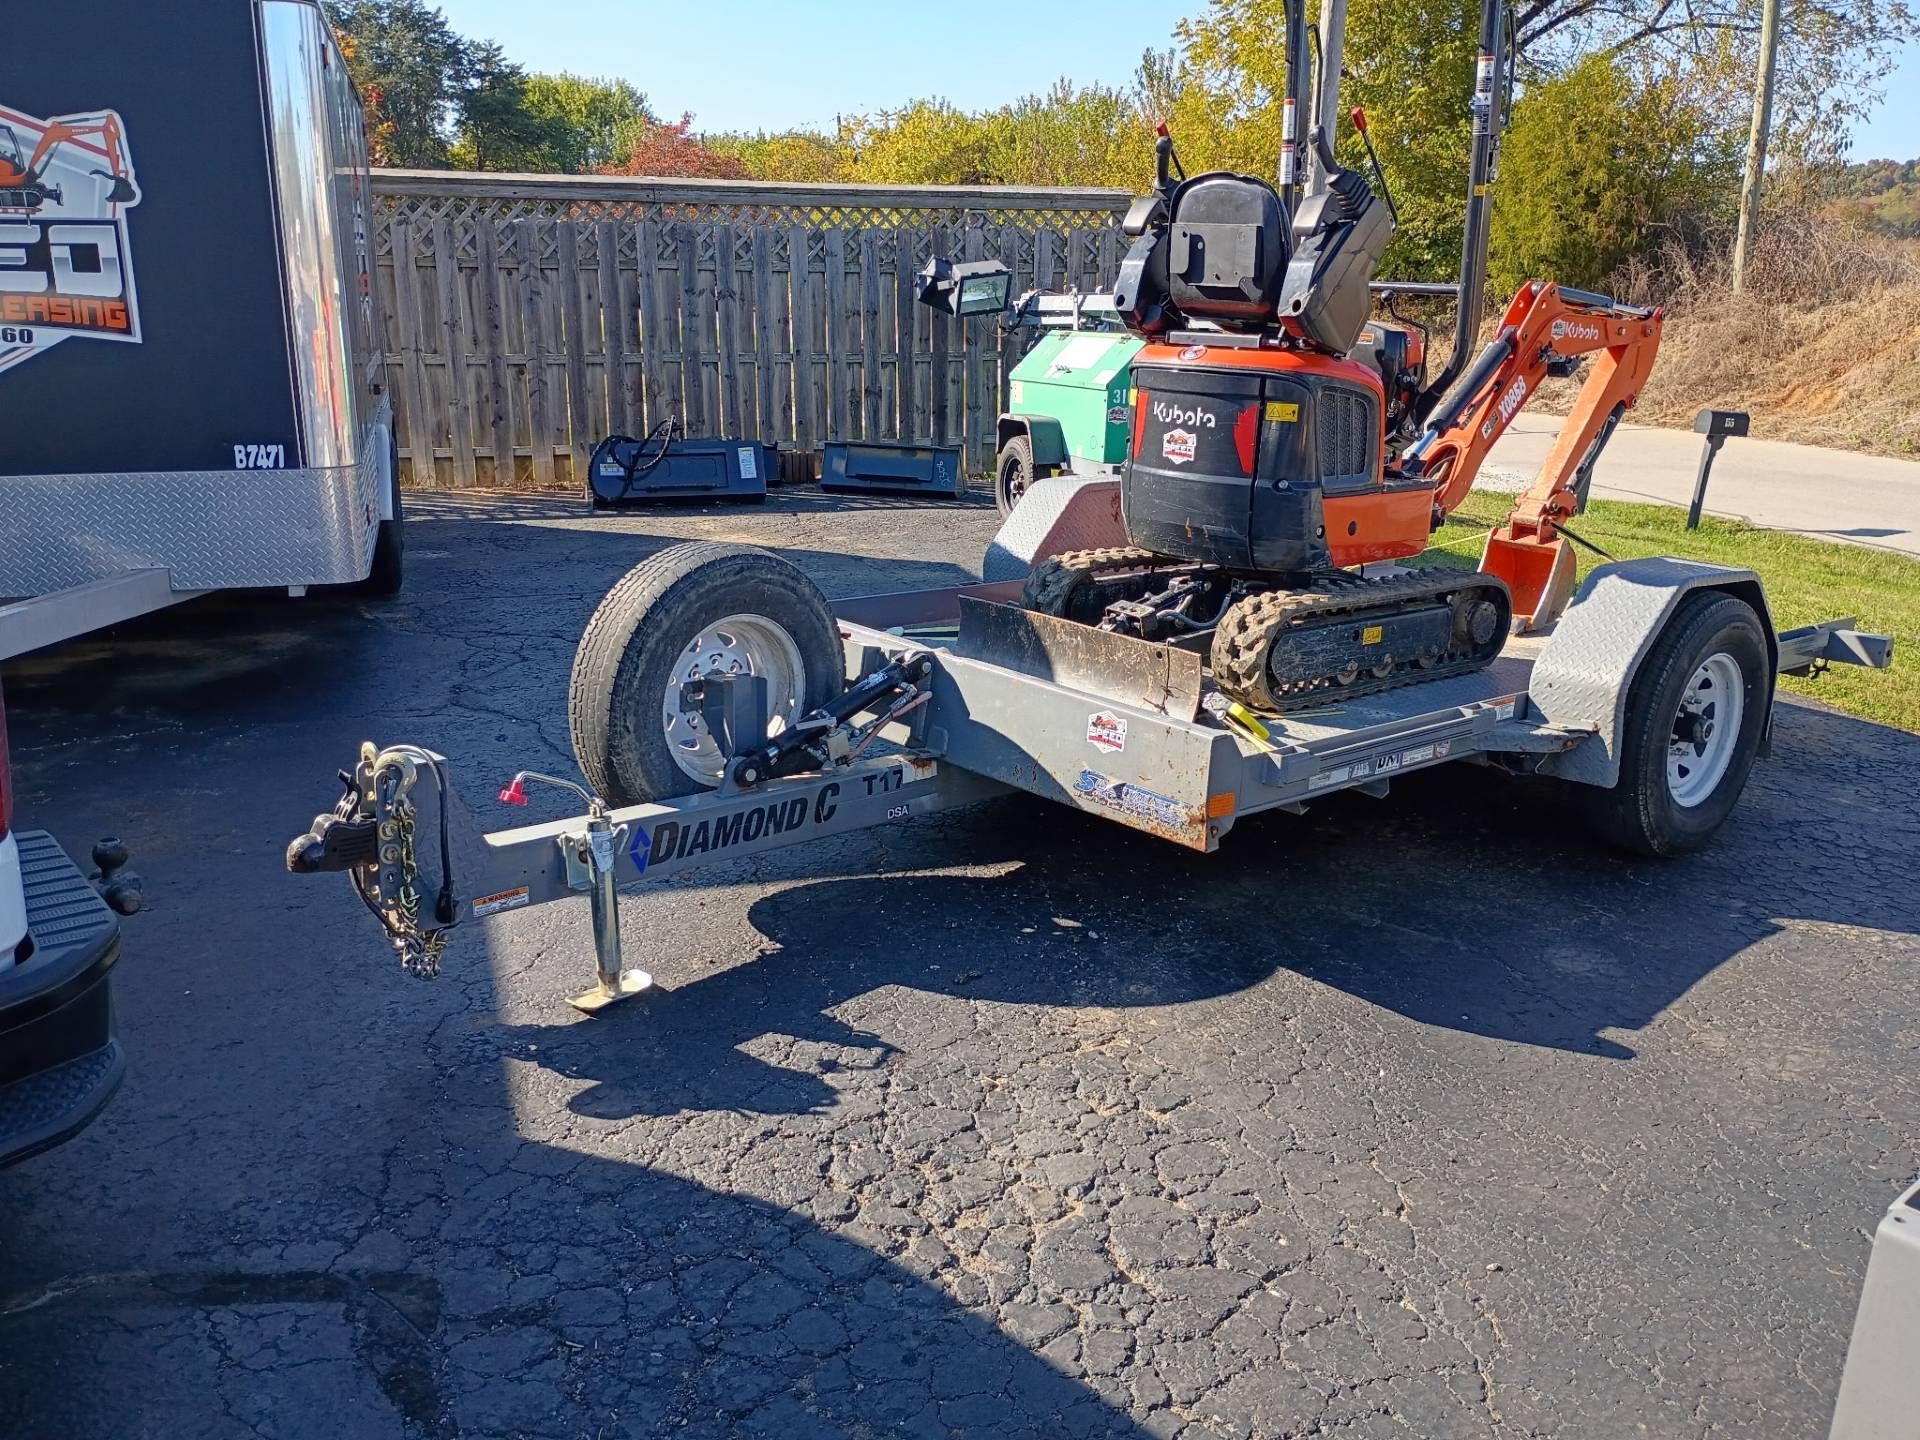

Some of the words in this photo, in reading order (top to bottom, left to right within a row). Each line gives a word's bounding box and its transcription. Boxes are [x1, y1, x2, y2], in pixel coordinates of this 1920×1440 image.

[0, 295, 127, 329] EASING
[0, 327, 34, 344] 60
[1566, 321, 1599, 340] Kubota
[1153, 401, 1216, 428] Kubota
[233, 444, 285, 469] B7471
[862, 769, 904, 796] T17
[647, 797, 808, 868] DIAMOND
[813, 782, 841, 824] C
[887, 805, 909, 820] DSA
